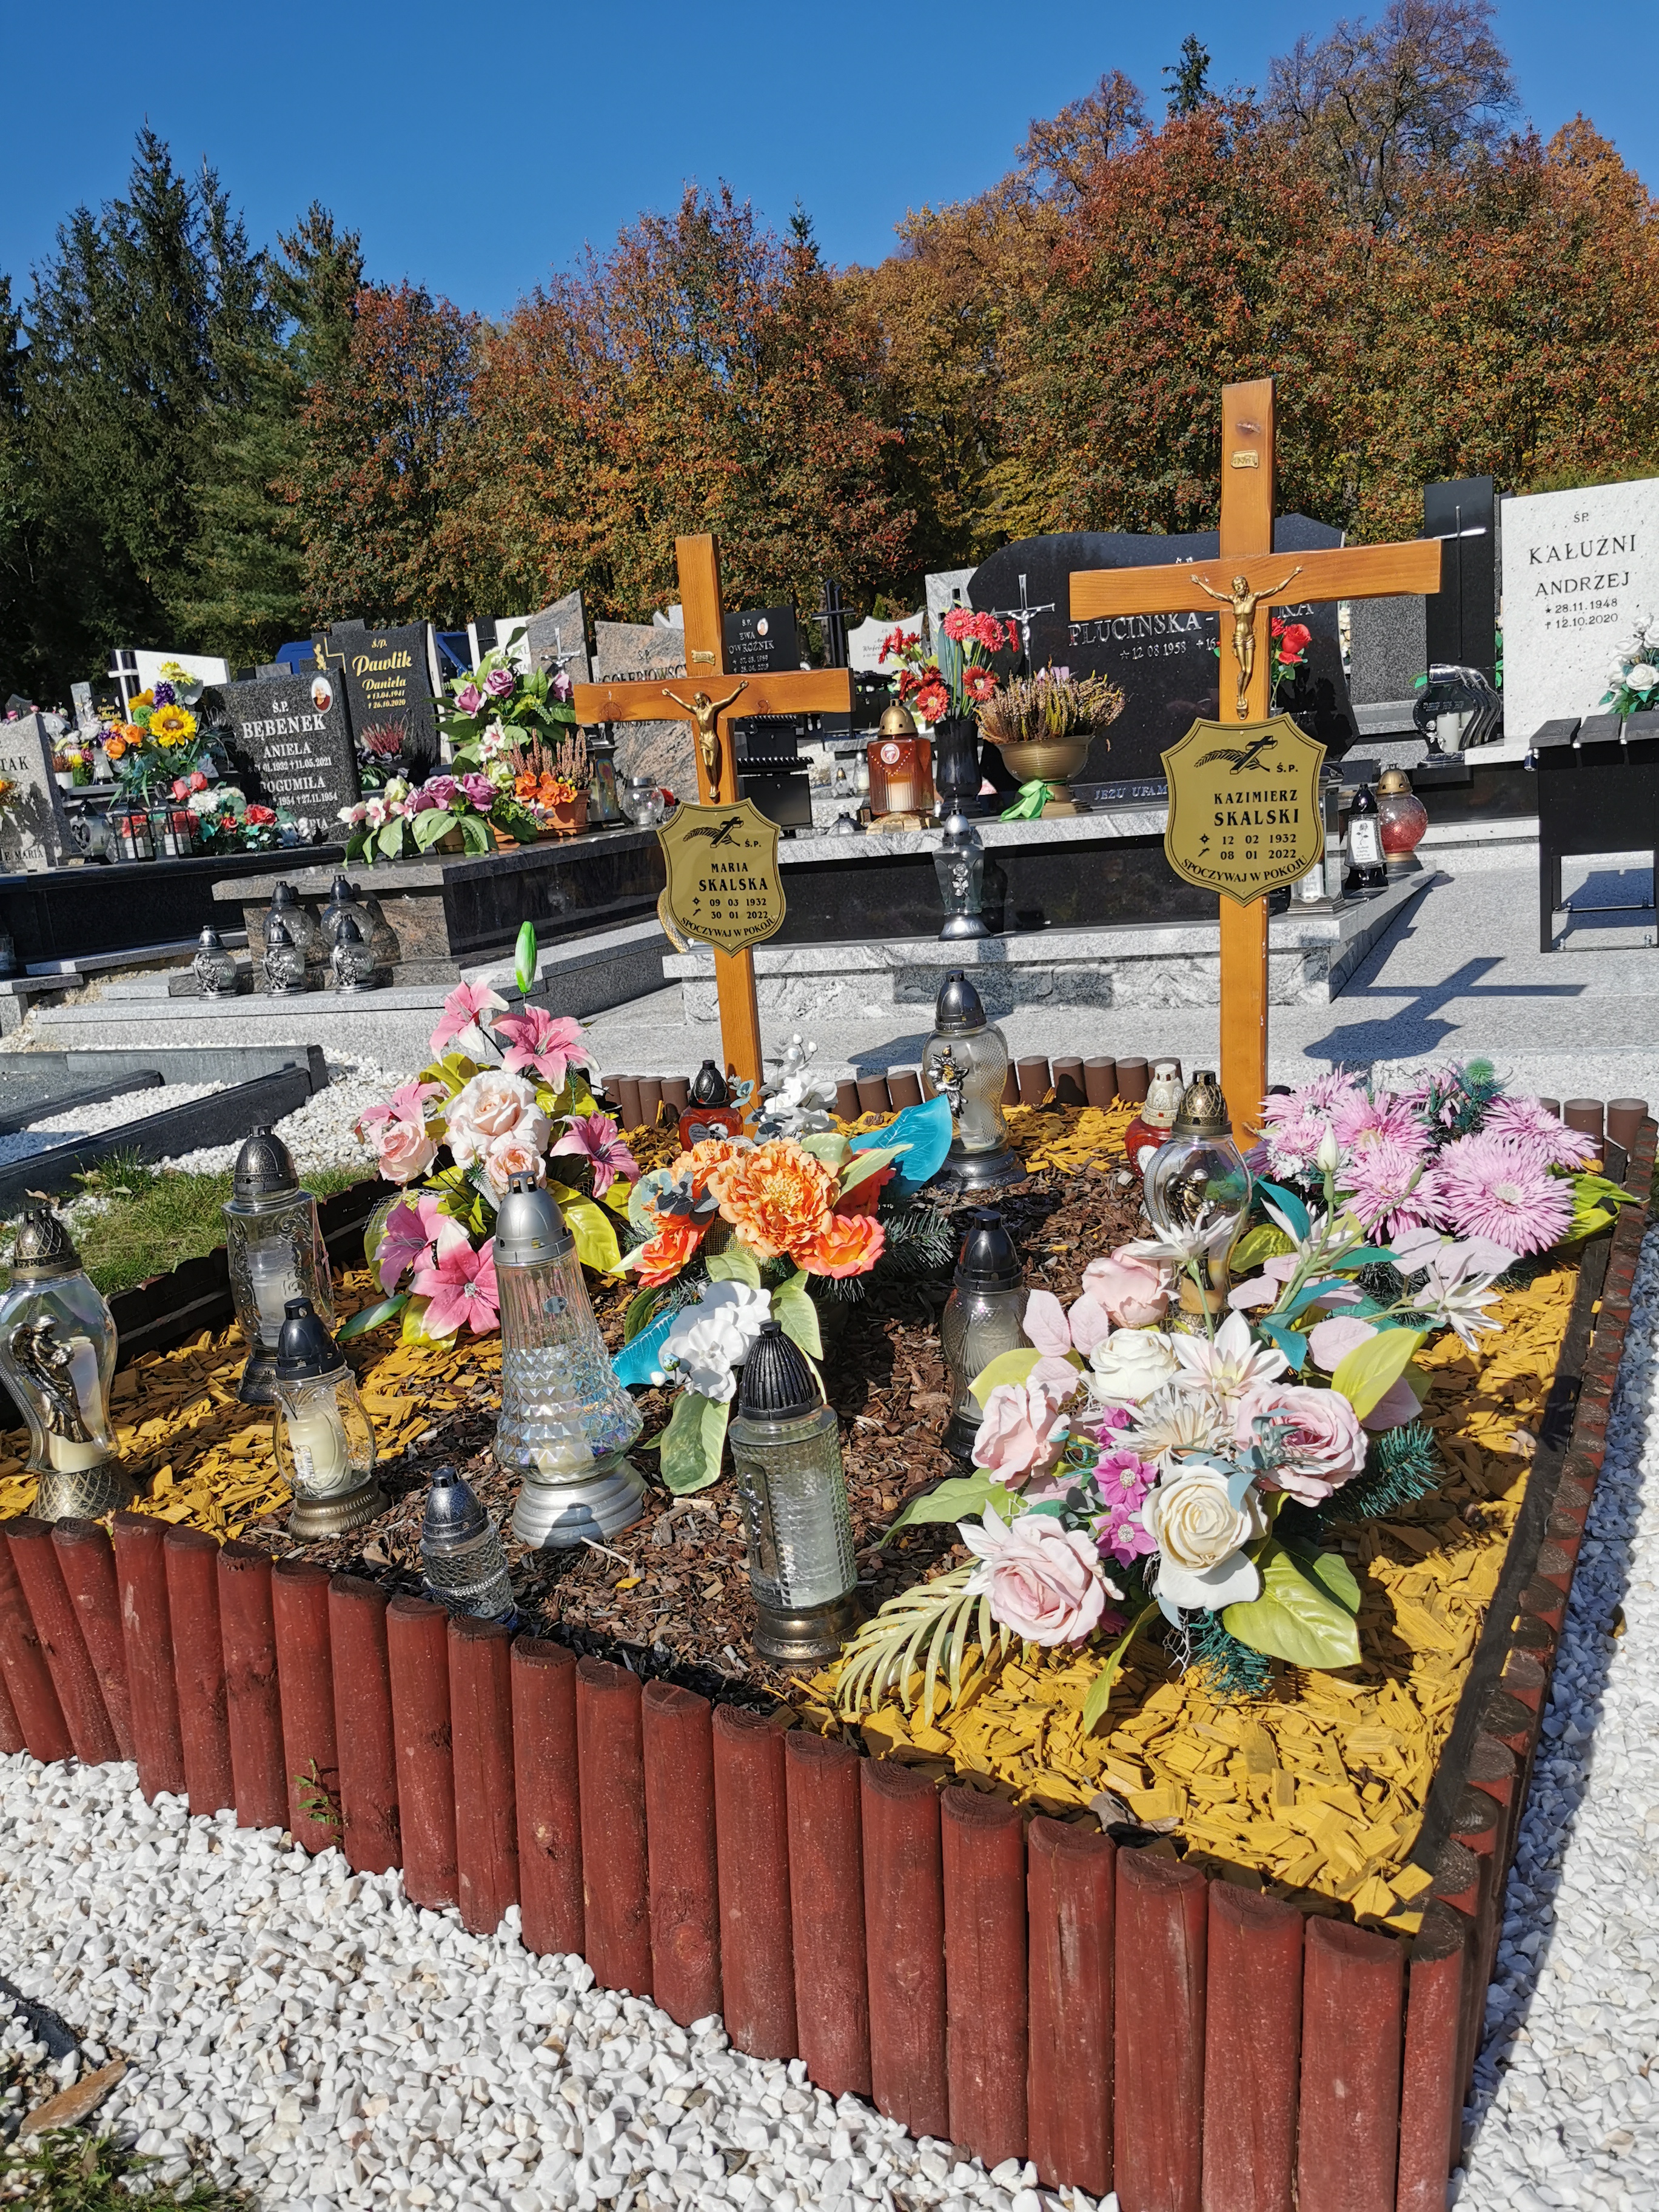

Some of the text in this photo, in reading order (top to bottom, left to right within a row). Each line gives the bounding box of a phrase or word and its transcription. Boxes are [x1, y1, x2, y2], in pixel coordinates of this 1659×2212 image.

[1535, 572, 1629, 597] ANDRZEJ
[1555, 598, 1618, 614] 28.11.1948
[1556, 613, 1618, 628] 12.10.2020
[1132, 646, 1144, 660] 12
[1163, 640, 1187, 656] 1958
[352, 650, 414, 677] Pawlik
[362, 675, 407, 691] Daniela
[242, 714, 326, 741] BĘBENEK
[263, 742, 312, 758] ANIELA
[1094, 784, 1168, 800] JEZU UFAM
[1214, 789, 1298, 805] KAZIMIERZ
[1214, 808, 1299, 826] SKALSKI
[1222, 834, 1296, 845] 12 02 1932
[15, 848, 44, 860] MARIA
[1220, 849, 1296, 860] 08 01 2022
[711, 862, 748, 873] MARIA
[1182, 855, 1307, 882] SPOCZYWAJ W POKOJU
[699, 877, 768, 891] SKALSKA
[680, 917, 732, 937] SPOCZYWAJ
[744, 915, 776, 936] POKOJU
